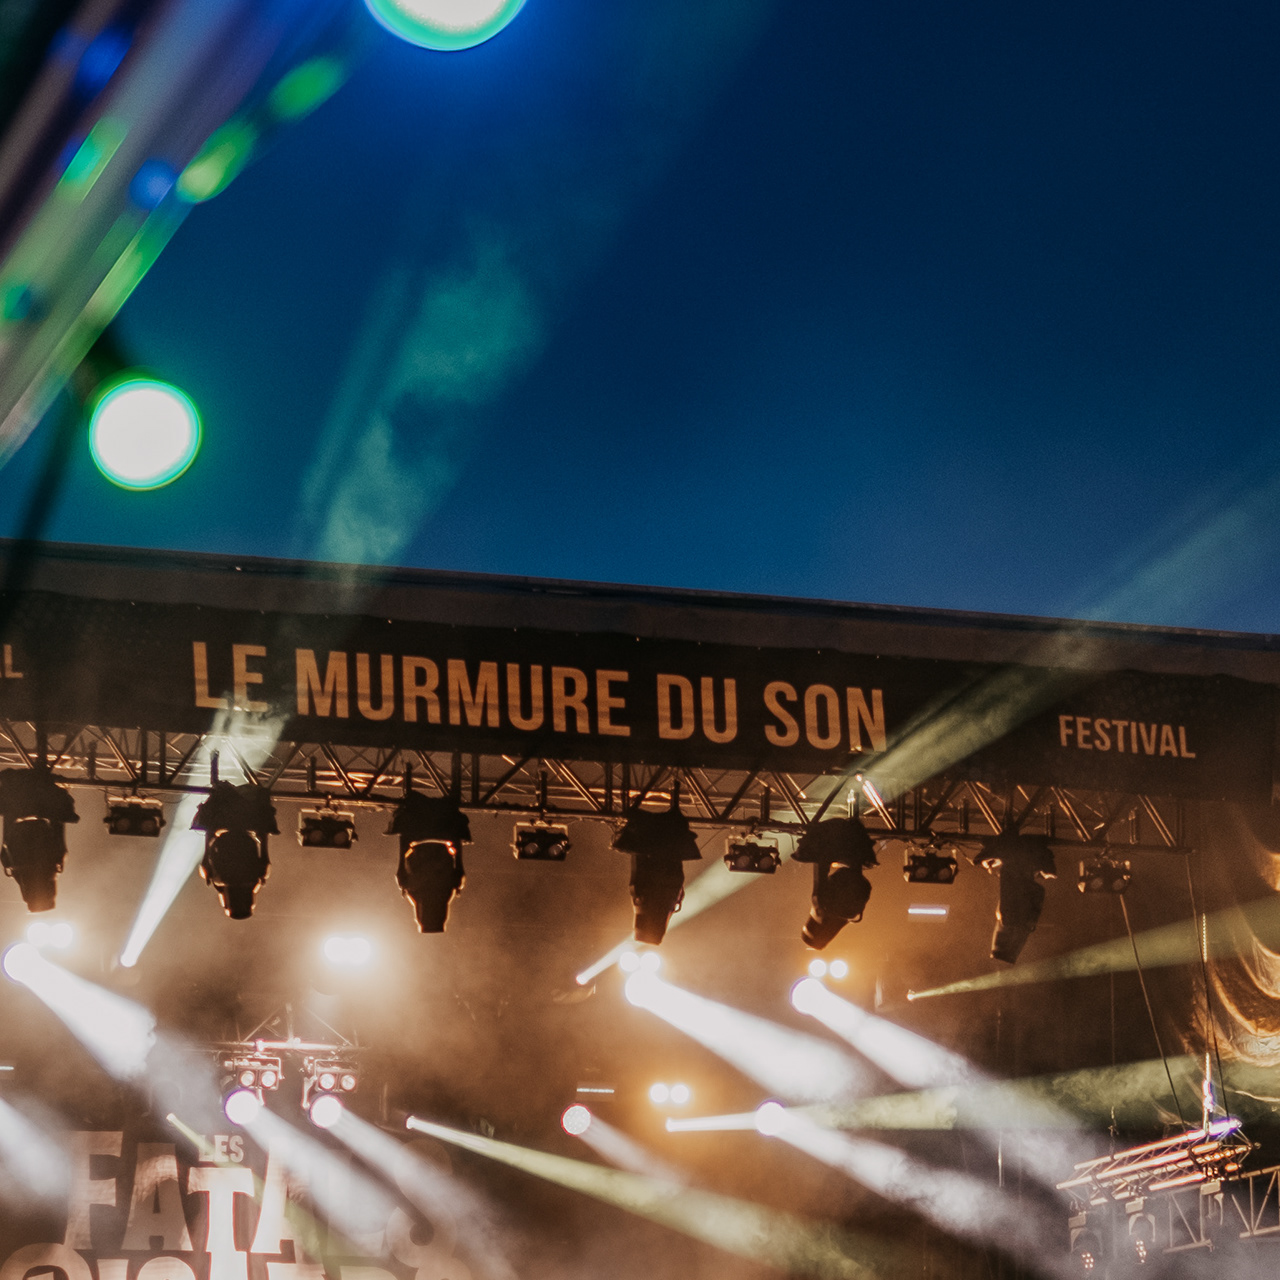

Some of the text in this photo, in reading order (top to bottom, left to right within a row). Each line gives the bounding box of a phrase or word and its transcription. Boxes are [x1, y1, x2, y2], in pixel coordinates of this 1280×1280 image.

[192, 642, 887, 753] LE MURMURE DU SON
[1058, 715, 1196, 759] FESTIVAL
[198, 1134, 245, 1164] LES
